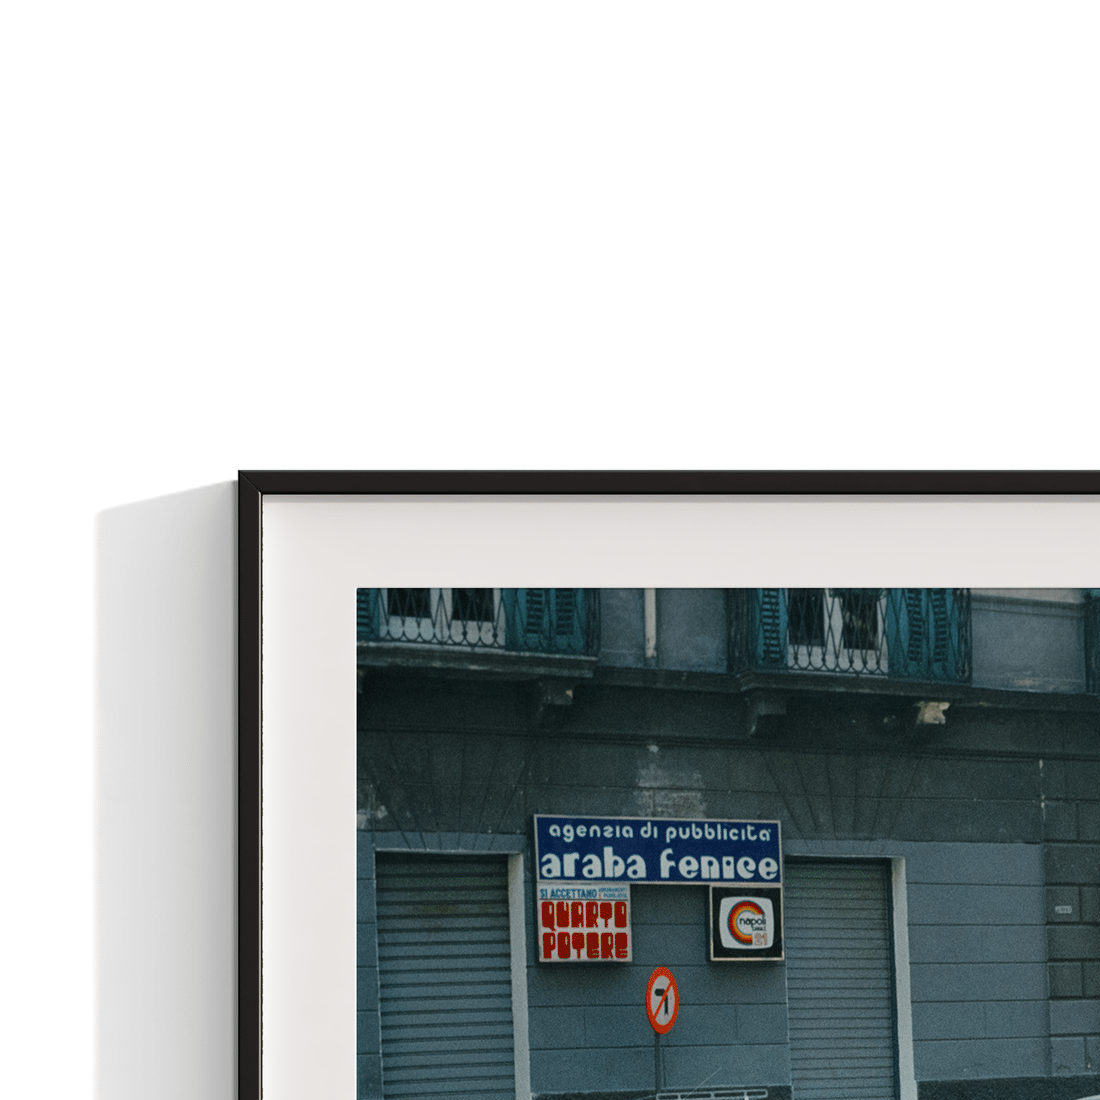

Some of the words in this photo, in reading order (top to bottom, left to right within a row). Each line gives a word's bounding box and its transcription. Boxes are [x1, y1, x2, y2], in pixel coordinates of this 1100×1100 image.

[549, 823, 634, 843] agenzia
[640, 821, 658, 839] di
[541, 846, 647, 879] araba
[660, 848, 779, 880] fenice
[540, 888, 548, 899] SI
[550, 888, 597, 899] ACCETTANO
[541, 901, 627, 931] QUARTO
[739, 913, 767, 929] napoli
[543, 932, 628, 959] POTERE
